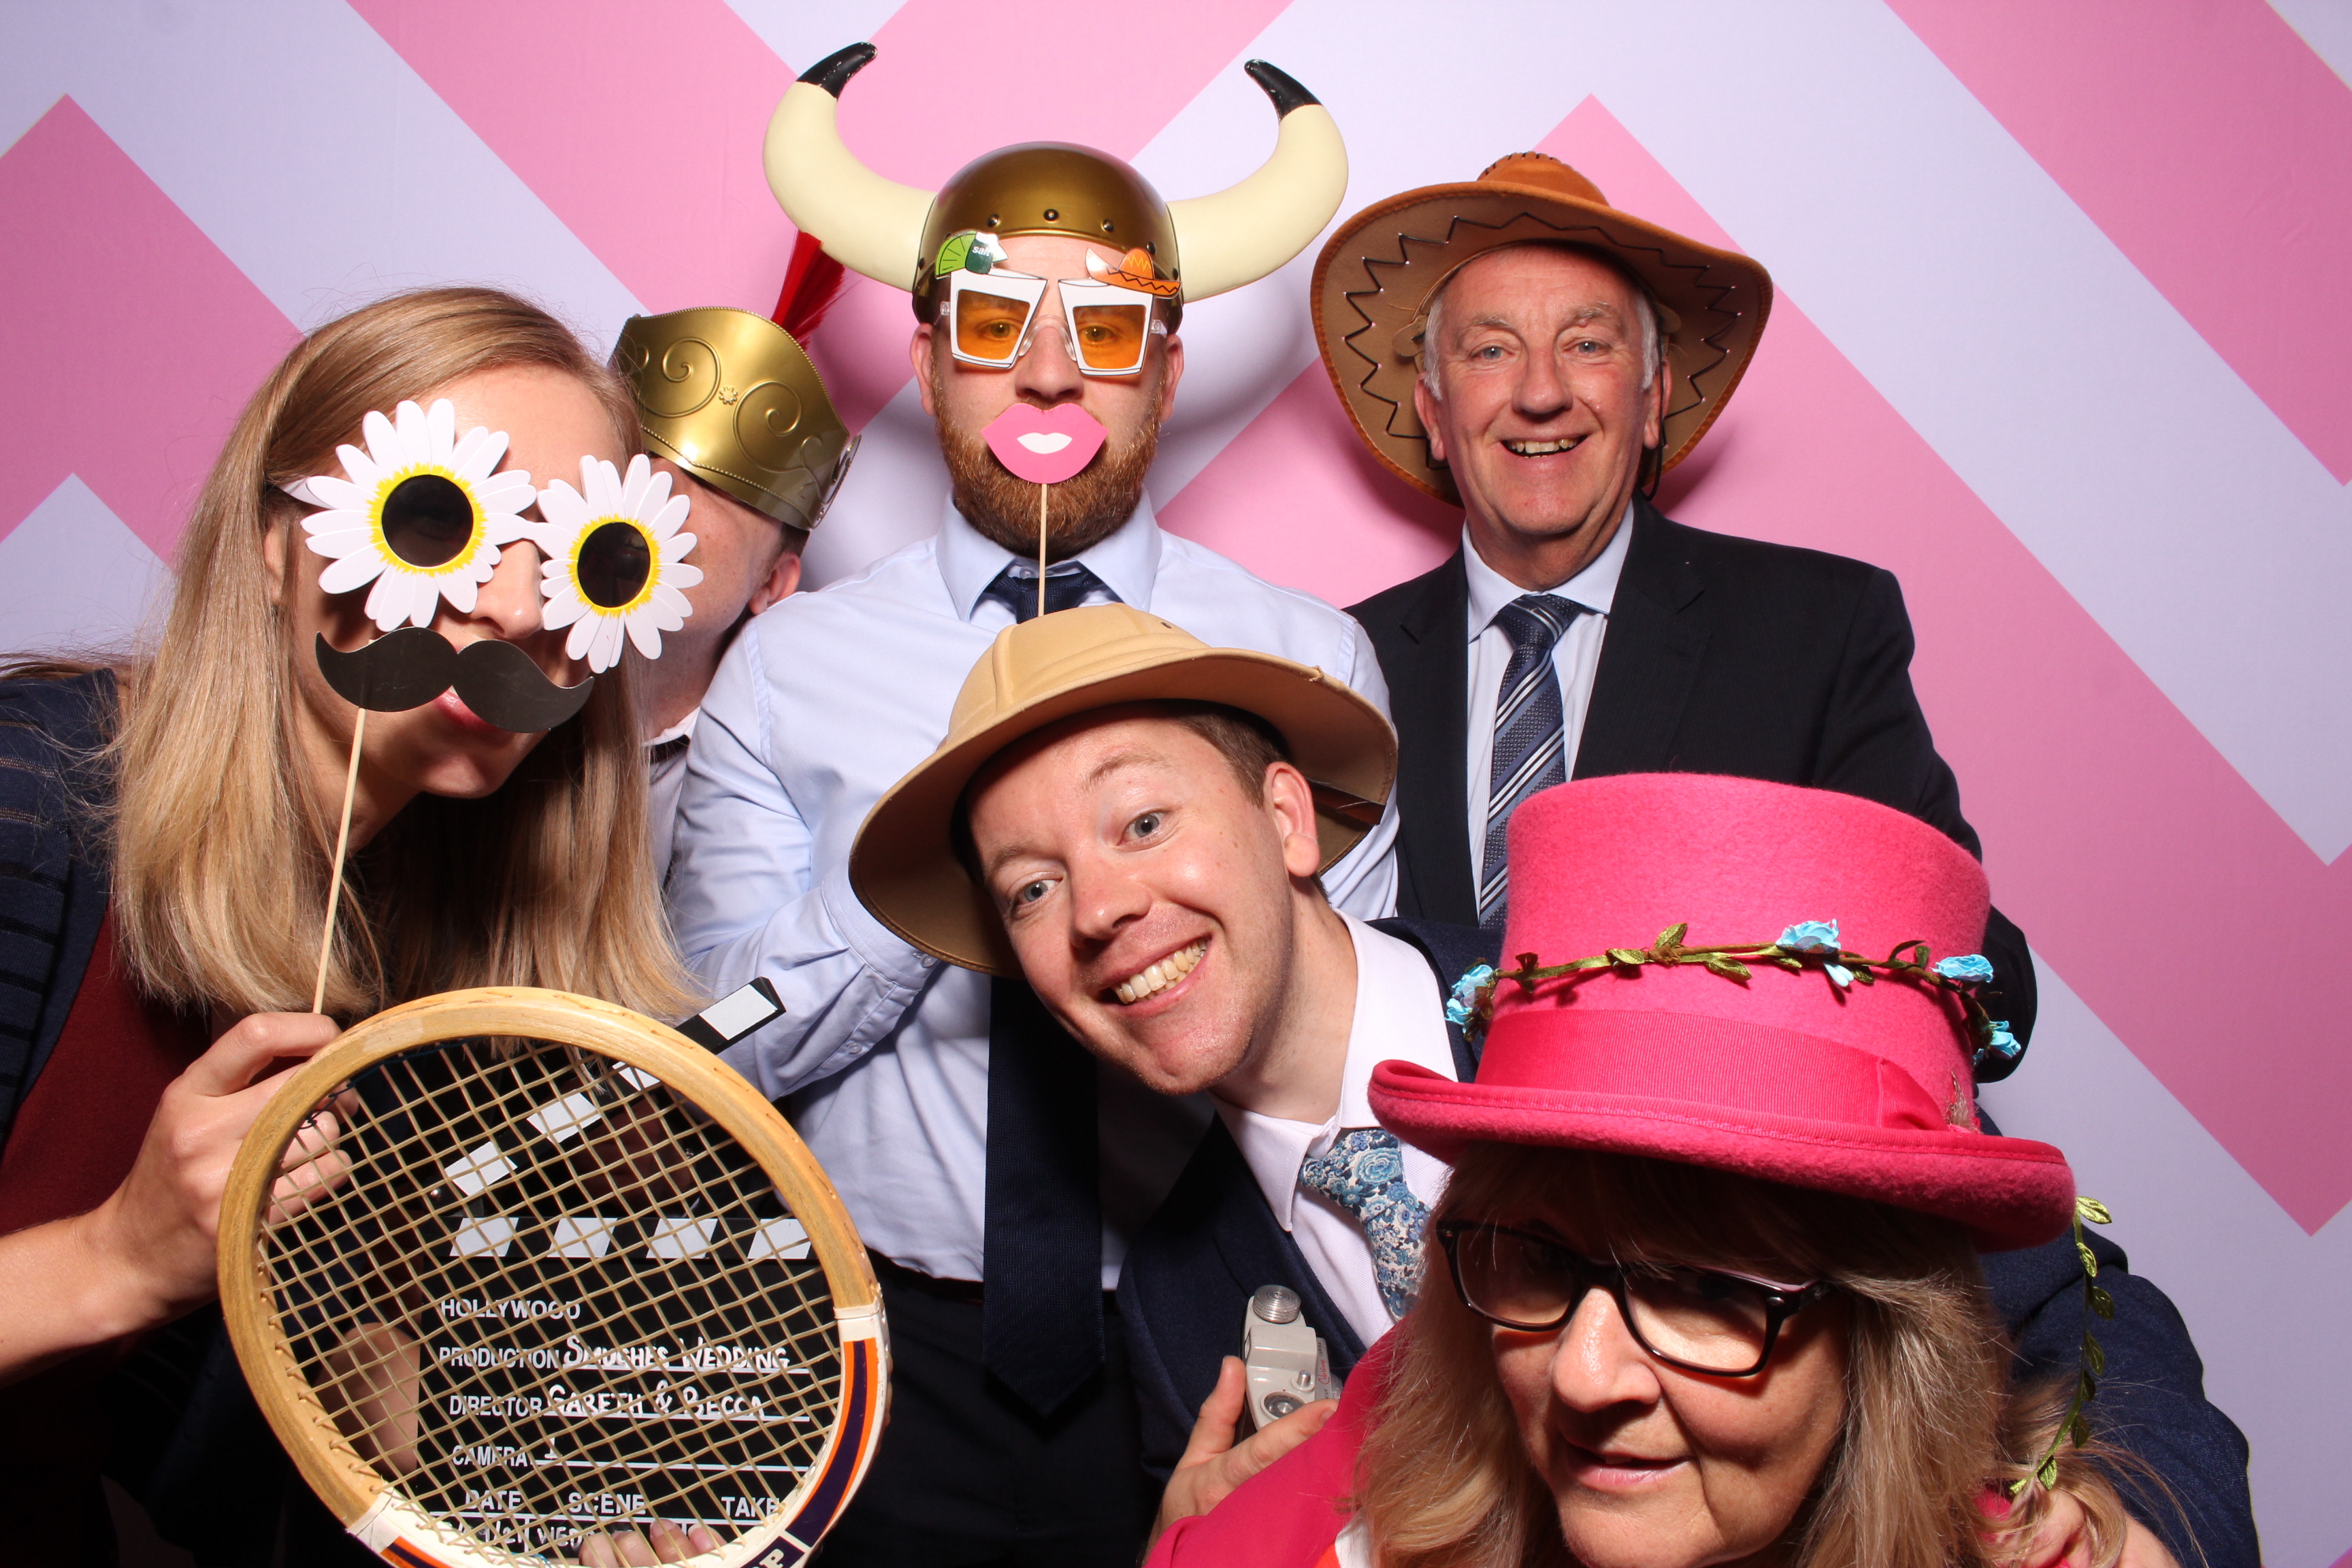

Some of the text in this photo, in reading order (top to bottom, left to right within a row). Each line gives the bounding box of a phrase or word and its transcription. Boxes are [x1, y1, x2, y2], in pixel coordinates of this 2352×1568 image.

[972, 246, 991, 257] salt
[441, 1298, 581, 1320] HOLLYWOOD
[439, 1347, 559, 1369] PRODUCTION
[679, 1337, 790, 1369] WEDDING
[450, 1379, 766, 1418] DIRECTOR GARETH & BECCA
[452, 1445, 528, 1467] CAMERA
[465, 1490, 522, 1510] DATE
[568, 1492, 647, 1514] SCENE
